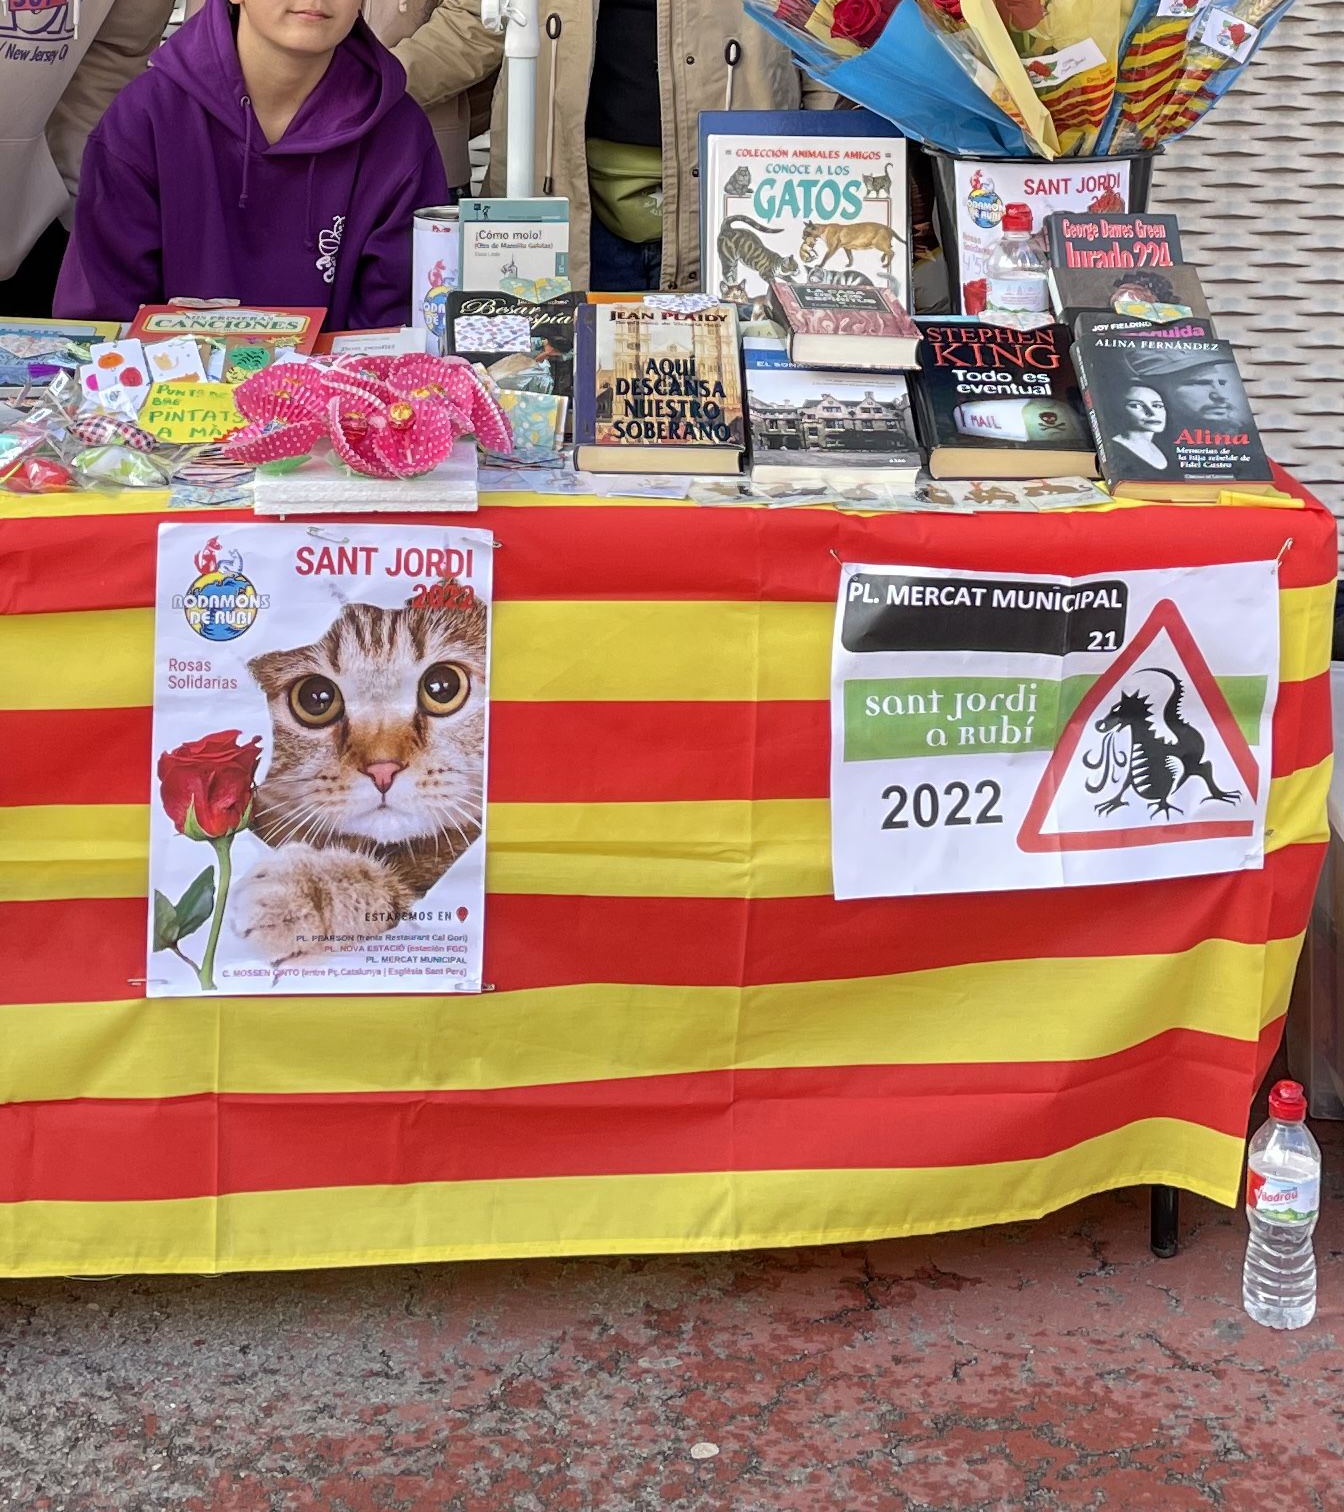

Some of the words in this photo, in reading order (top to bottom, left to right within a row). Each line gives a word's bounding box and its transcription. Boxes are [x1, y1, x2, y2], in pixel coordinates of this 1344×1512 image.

[6, 45, 29, 60] New
[30, 46, 58, 65] Jersey
[736, 148, 788, 158] COLECCIÓN
[792, 150, 840, 159] ANIMALES
[843, 151, 881, 160] AMIGOS
[766, 163, 810, 174] CONOCE
[815, 166, 823, 174] A
[828, 165, 850, 175] LOS
[1024, 178, 1072, 196] SANT
[1076, 173, 1120, 192] JORDI
[753, 177, 863, 224] GATOS
[1062, 219, 1099, 241] George
[1101, 220, 1133, 239] Dawes
[1135, 220, 1166, 238] Green
[155, 319, 299, 330] CANCIONES
[609, 311, 654, 322] JEAN
[660, 311, 728, 322] PLAIDY
[1092, 324, 1109, 332] JOY
[1110, 321, 1152, 331] FIELDING
[926, 327, 1054, 344] STEPHEN
[1095, 339, 1136, 348] ALINA
[1140, 340, 1219, 351] FERNÁNDEZ
[929, 343, 1061, 369] KING
[645, 355, 696, 377] AQUÍ
[952, 369, 1012, 382] Todo
[1023, 372, 1050, 383] es
[616, 377, 726, 398] DESCANSA
[957, 383, 1052, 395] eventual
[149, 409, 244, 424] PINTATS
[624, 399, 721, 419] NUESTRO
[971, 415, 1002, 429] MAIL
[157, 427, 172, 438] A
[613, 420, 731, 442] SOBERANO
[1173, 428, 1250, 445] Alina
[295, 546, 378, 577] SANT
[385, 548, 473, 579] JORDI
[411, 583, 475, 610] 2022
[849, 581, 879, 604] PL.
[886, 584, 987, 608] MERCAT
[992, 588, 1122, 613] MUNICIPAL
[189, 610, 210, 625] DE
[215, 610, 253, 625] RUBI
[1087, 630, 1118, 650] 21
[168, 658, 211, 672] Rosas
[168, 675, 237, 689] Solidarias
[865, 688, 944, 716] sant
[926, 729, 949, 747] a
[880, 779, 1003, 830] 2022
[365, 912, 433, 923] ESTAREMOS
[438, 911, 452, 921] EN
[1254, 1187, 1298, 1202] Viladrau
